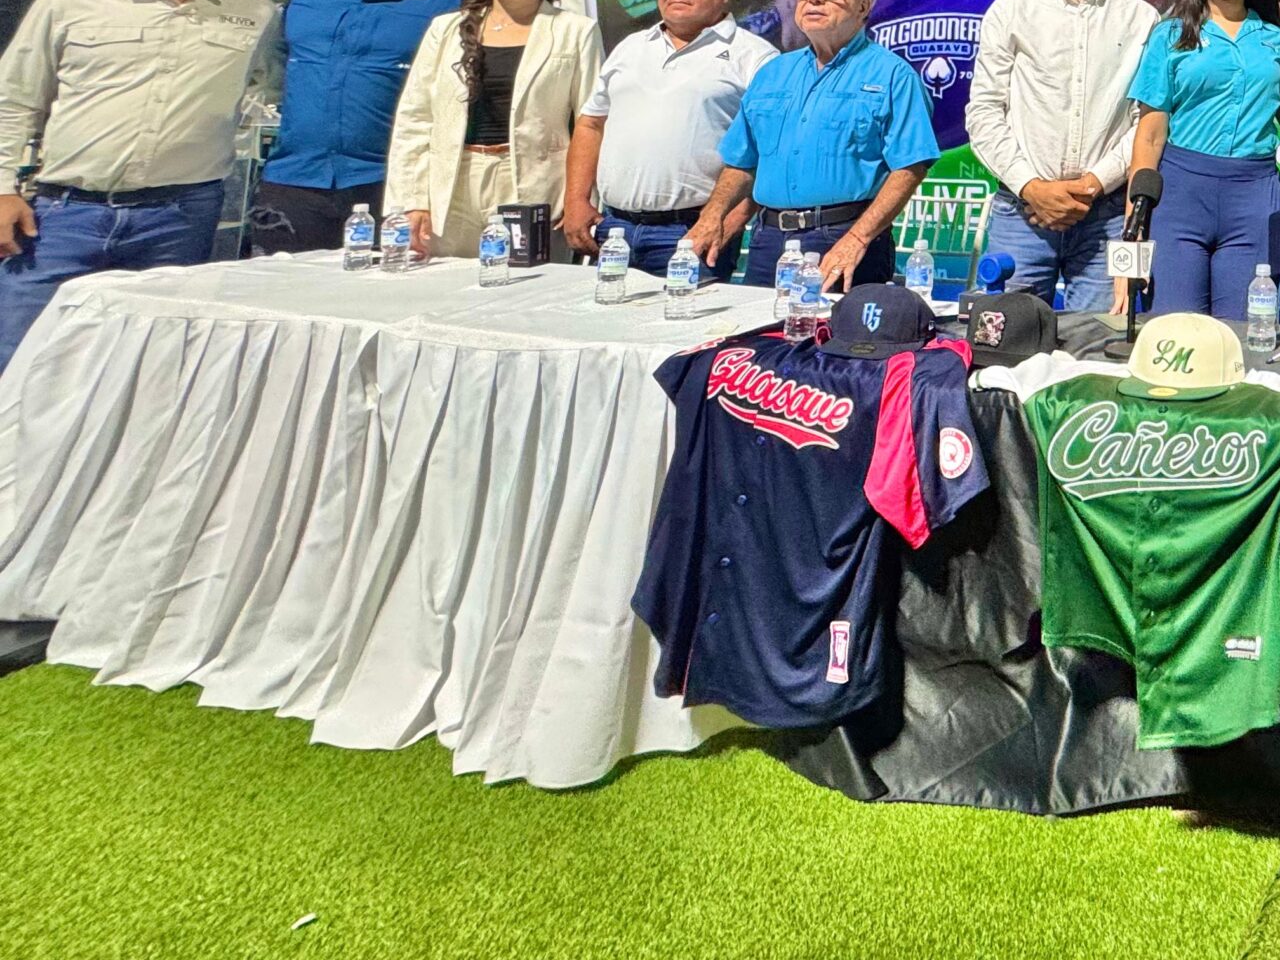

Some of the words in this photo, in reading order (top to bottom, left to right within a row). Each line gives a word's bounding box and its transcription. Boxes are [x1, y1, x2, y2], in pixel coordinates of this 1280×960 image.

[877, 17, 981, 50] ALGODONER
[912, 43, 969, 54] GUASAVE
[908, 184, 984, 225] LIVE
[706, 347, 854, 433] Guasave
[1047, 400, 1267, 482] Cañeros
